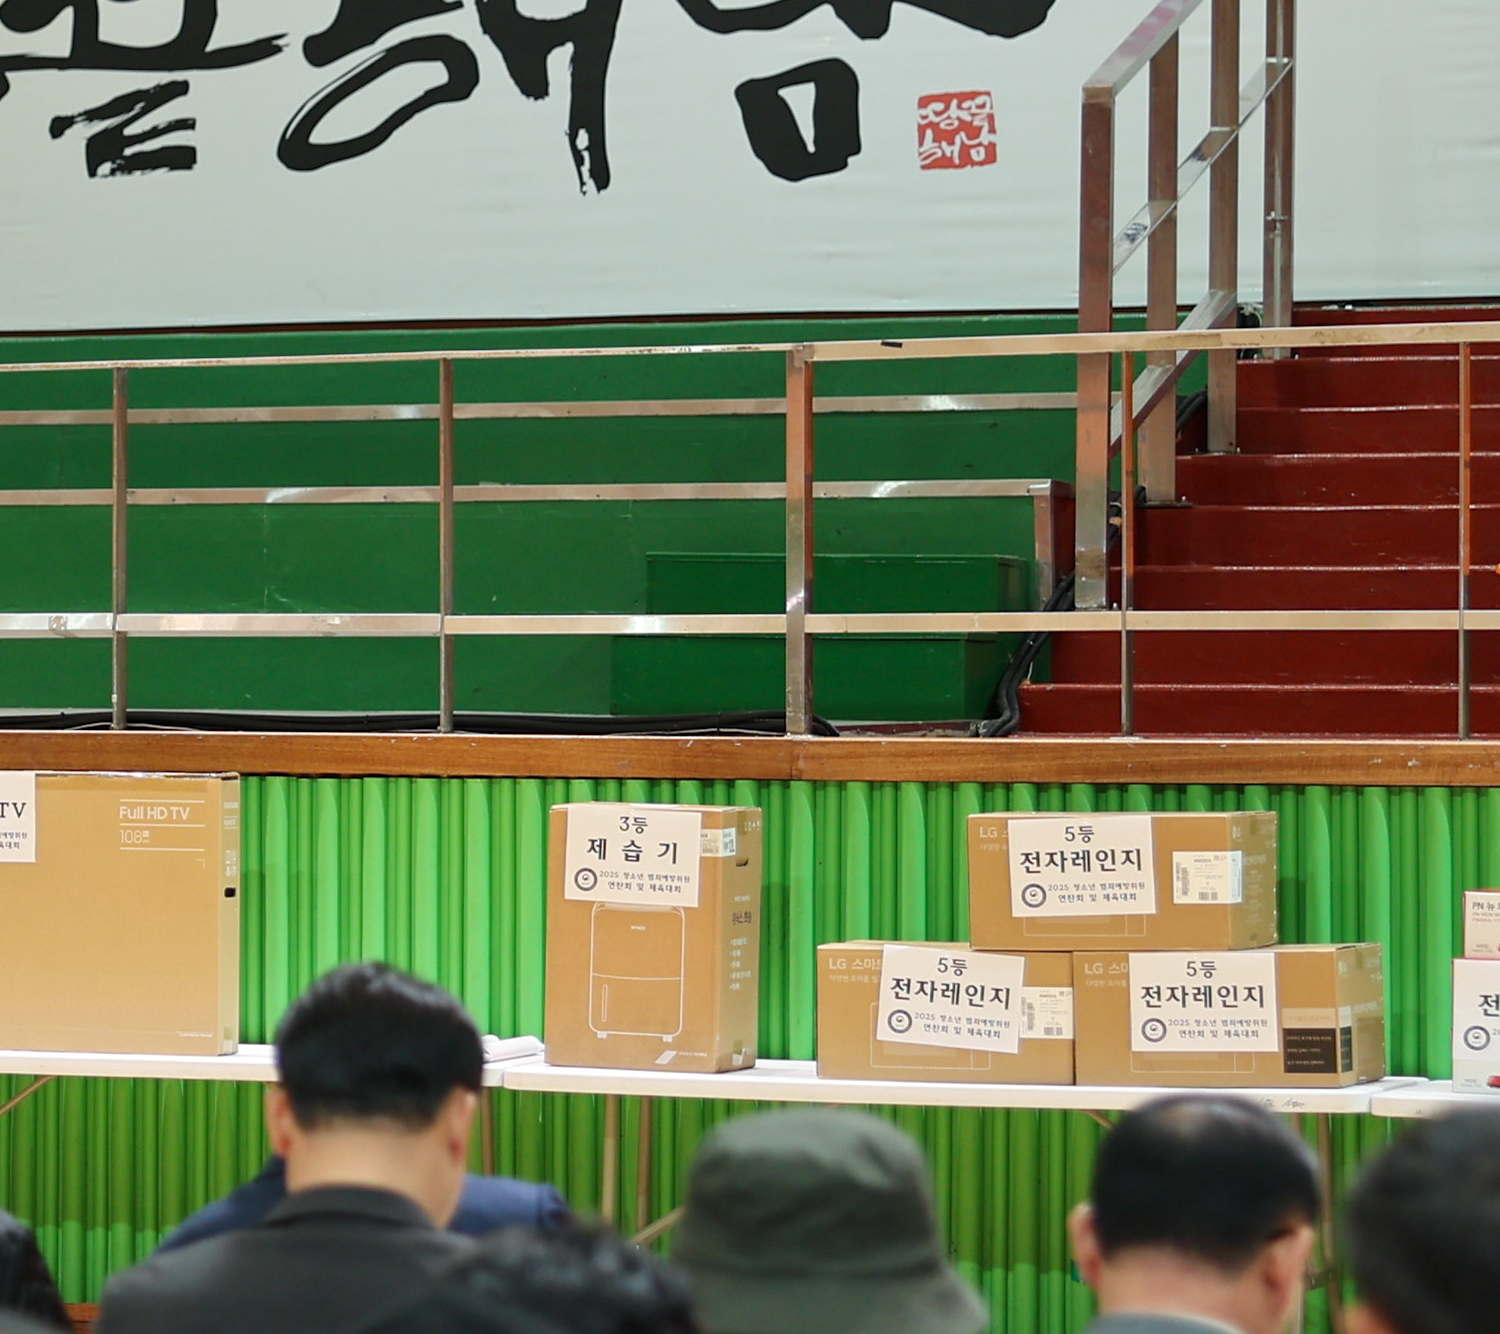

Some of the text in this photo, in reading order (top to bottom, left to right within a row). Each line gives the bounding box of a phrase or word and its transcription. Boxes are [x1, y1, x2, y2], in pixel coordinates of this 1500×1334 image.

[119, 805, 190, 820] Full HD TV
[619, 816, 648, 834] 3등
[980, 826, 998, 838] LG
[120, 829, 142, 844] 108
[1064, 825, 1095, 843] 5등
[1019, 848, 1142, 875] 전자레인지
[1047, 881, 1146, 893] 2025 청소년 범죄예방위원
[829, 958, 847, 970] LG
[937, 957, 968, 977] 5등
[1084, 962, 1103, 975] LG
[1186, 960, 1217, 979] 5등
[890, 977, 1011, 1010] 전자레인지
[1140, 985, 1265, 1010] 전자레인지
[1167, 1018, 1268, 1028] 2025 청소년 범죄예방위원
